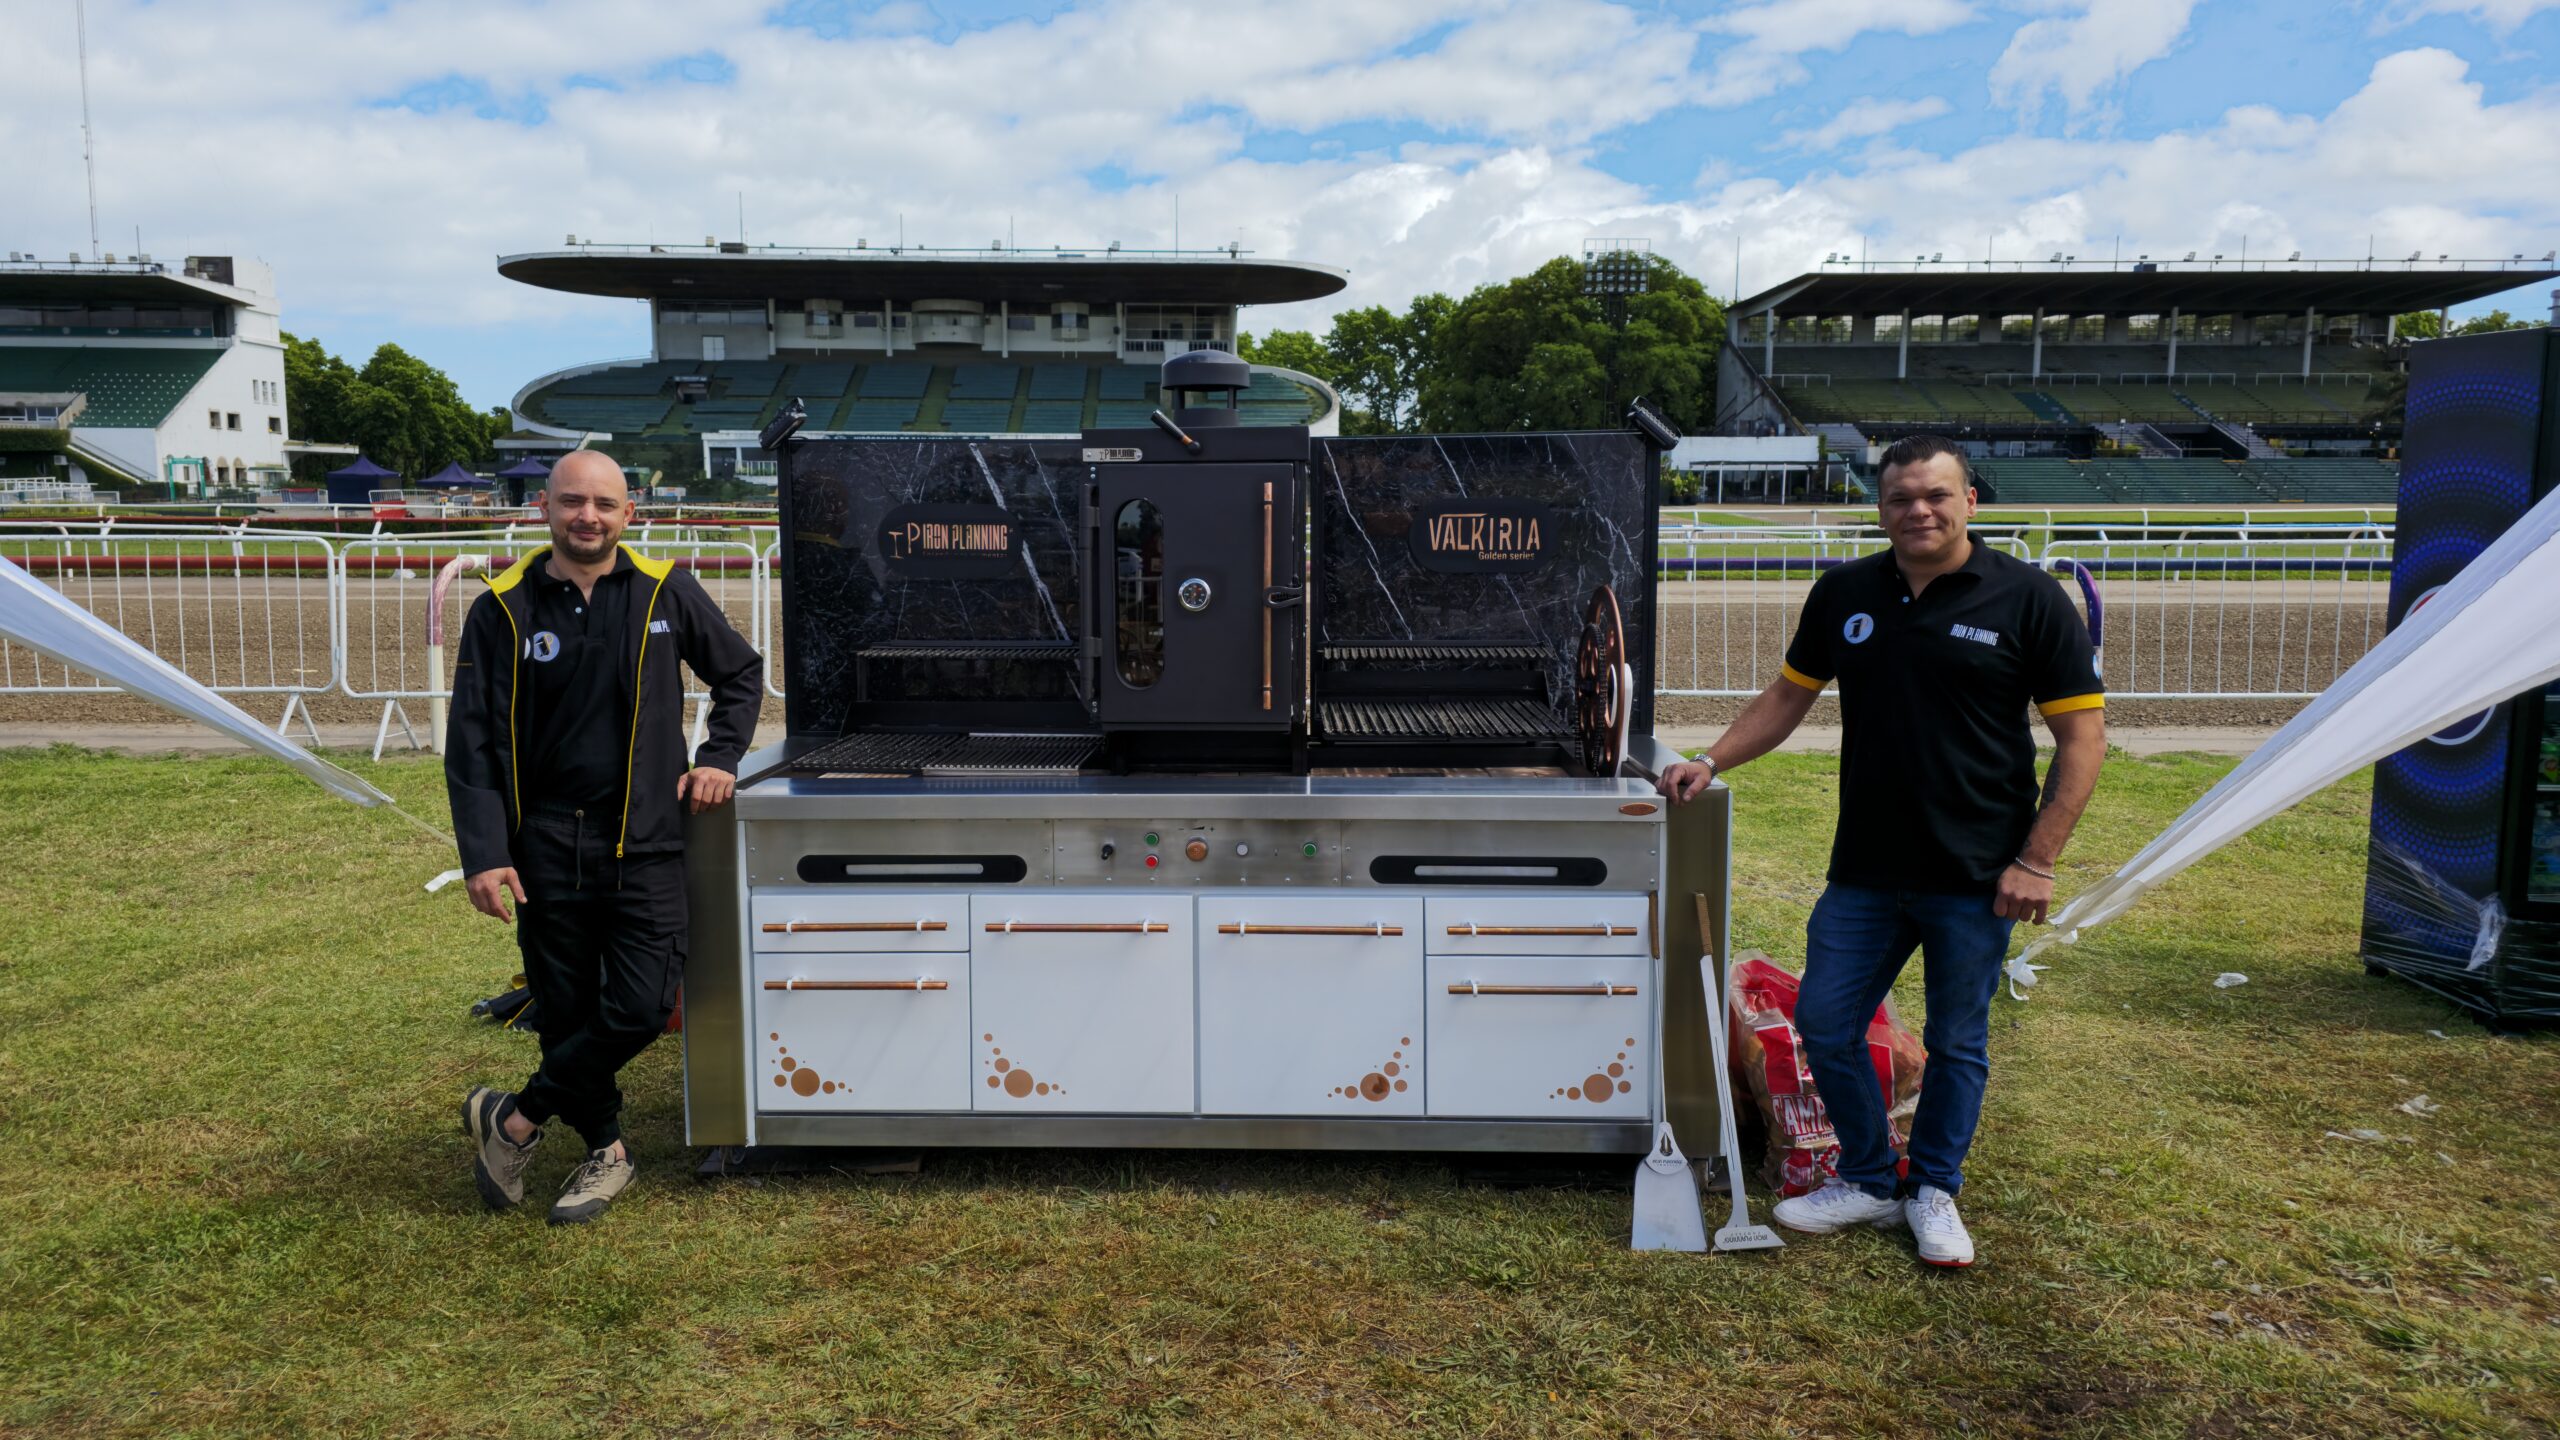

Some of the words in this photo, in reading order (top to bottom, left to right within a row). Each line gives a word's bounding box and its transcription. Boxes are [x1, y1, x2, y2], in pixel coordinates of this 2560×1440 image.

[922, 523, 949, 550] IRON
[952, 524, 1008, 551] PLANNING
[1429, 513, 1541, 551] VALKIRIA
[1478, 551, 1507, 560] Golden
[1509, 552, 1535, 560] series
[1950, 623, 1968, 638] IRON
[1966, 626, 1999, 647] PLANNING
[1772, 1094, 1834, 1136] CAMP
